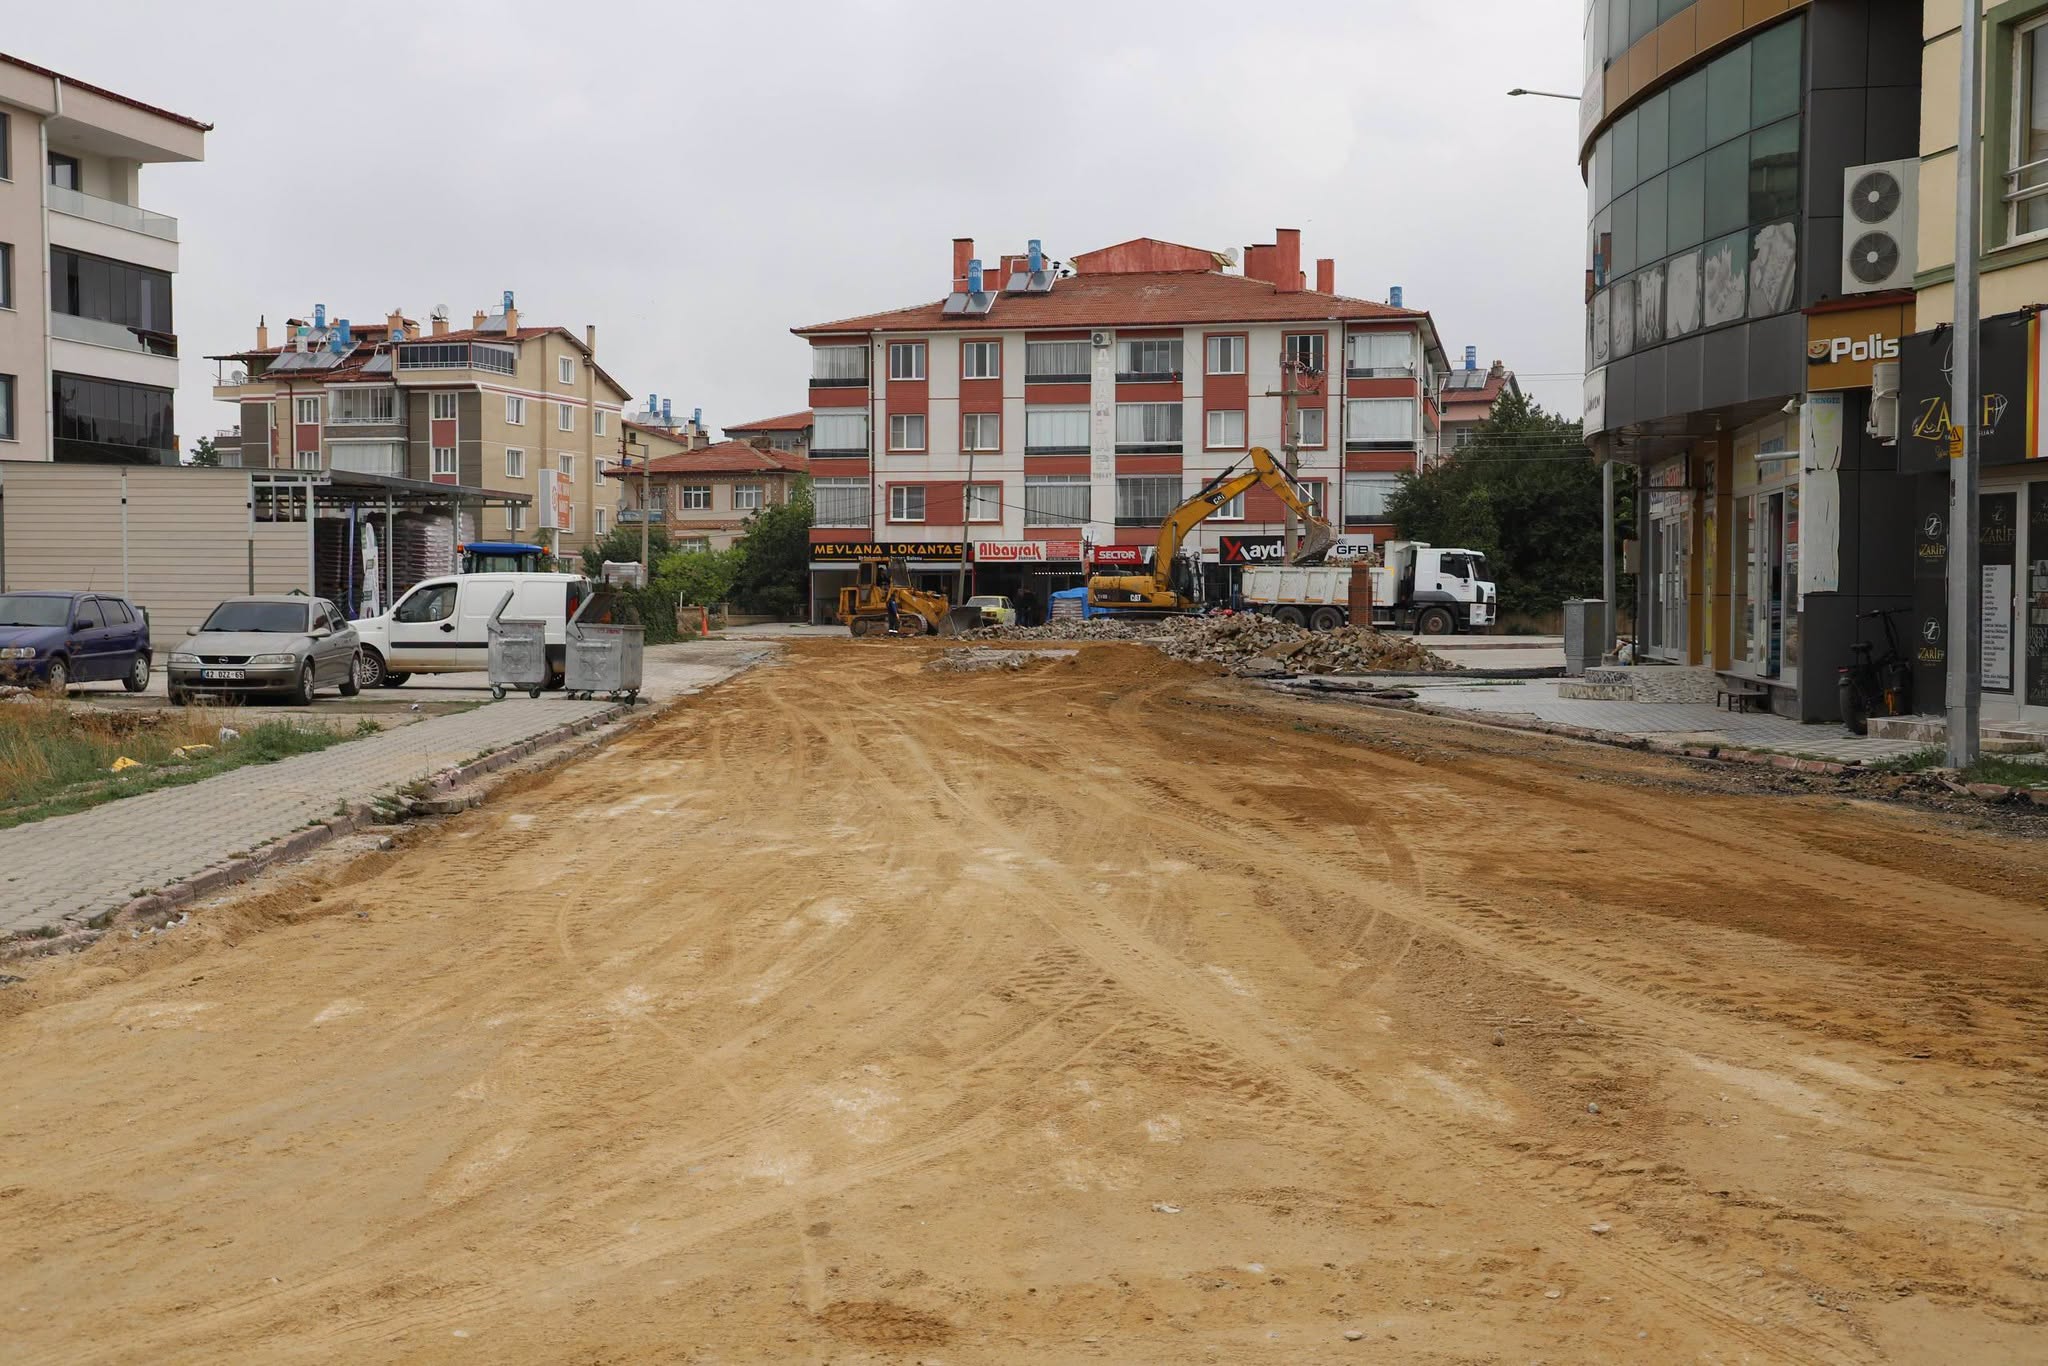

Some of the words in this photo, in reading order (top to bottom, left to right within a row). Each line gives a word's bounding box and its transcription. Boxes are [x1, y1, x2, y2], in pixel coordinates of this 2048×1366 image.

[1830, 333, 1899, 363] Polis
[1913, 394, 1998, 440] ZAF
[814, 544, 883, 554] MEVLANA
[890, 544, 964, 554] LOKANTAS
[979, 543, 1042, 560] Albayrak
[1336, 545, 1369, 555] GFB
[1098, 550, 1136, 559] SECTOR
[1130, 594, 1142, 602] CAT
